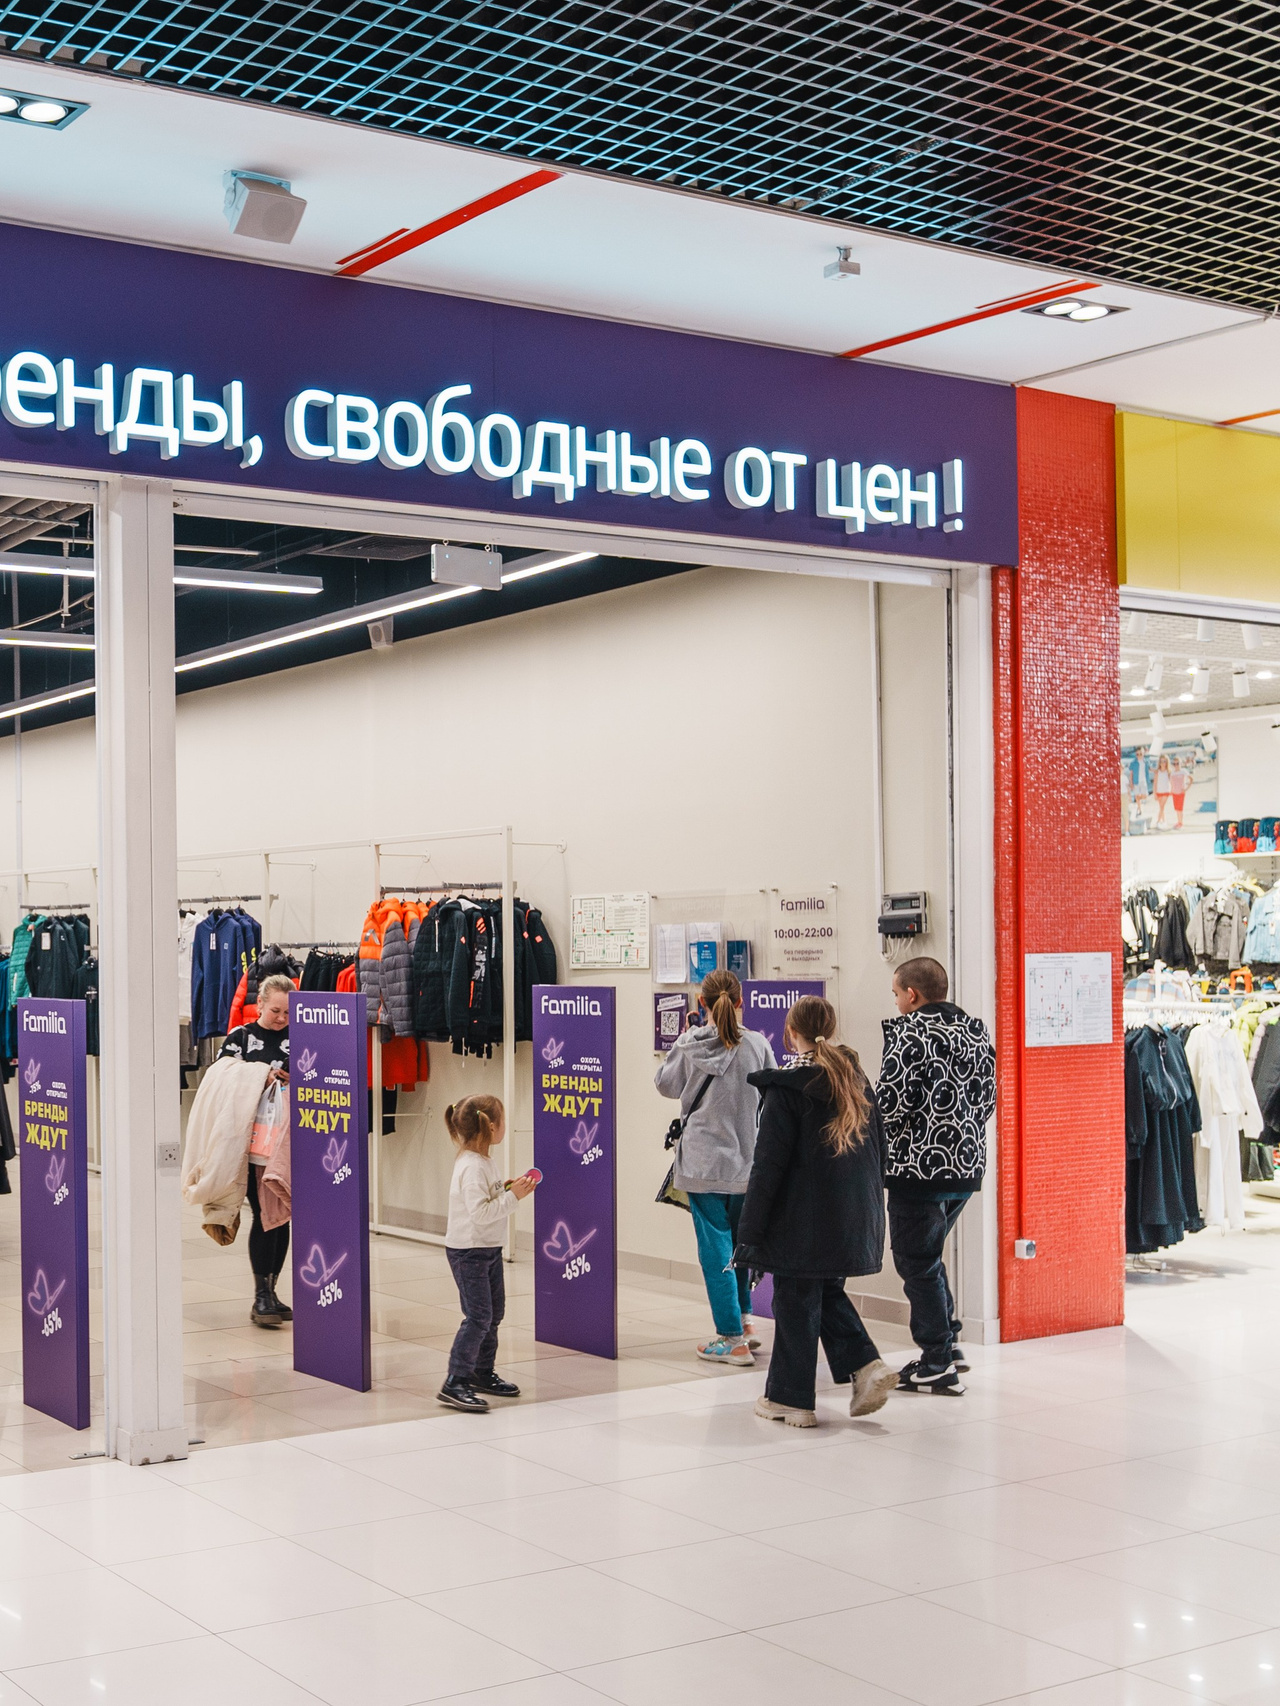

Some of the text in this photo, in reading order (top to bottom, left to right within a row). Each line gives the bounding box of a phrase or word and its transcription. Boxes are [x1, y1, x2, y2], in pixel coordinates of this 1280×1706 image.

[284, 384, 712, 504] свободные
[725, 446, 808, 513] от
[780, 898, 825, 911] familia
[774, 927, 833, 939] 10:00-22:00
[541, 995, 602, 1016] familia
[750, 990, 806, 1010] famili
[23, 1010, 67, 1034] familia
[296, 1003, 350, 1026] familia
[331, 1069, 349, 1077] ОХОТА
[548, 1056, 565, 1069] -75%
[572, 1064, 602, 1072] ОТКРЫТА!
[303, 1069, 318, 1082] -75%
[324, 1076, 351, 1086] ОТКРЫТА!
[542, 1074, 603, 1093] БРЕНДЫ
[297, 1087, 351, 1108] БРЕНДЫ
[543, 1093, 603, 1118] ЖДУТ
[24, 1100, 68, 1123] БРЕНДЫ
[298, 1108, 351, 1134] ЖДУТ
[25, 1122, 68, 1151] ЖДУТ
[581, 1144, 603, 1166] -85%
[332, 1162, 352, 1185] -85%
[53, 1182, 69, 1206] -85%
[562, 1253, 591, 1281] -65%
[317, 1279, 343, 1308] -65%
[41, 1307, 62, 1337] -65%
